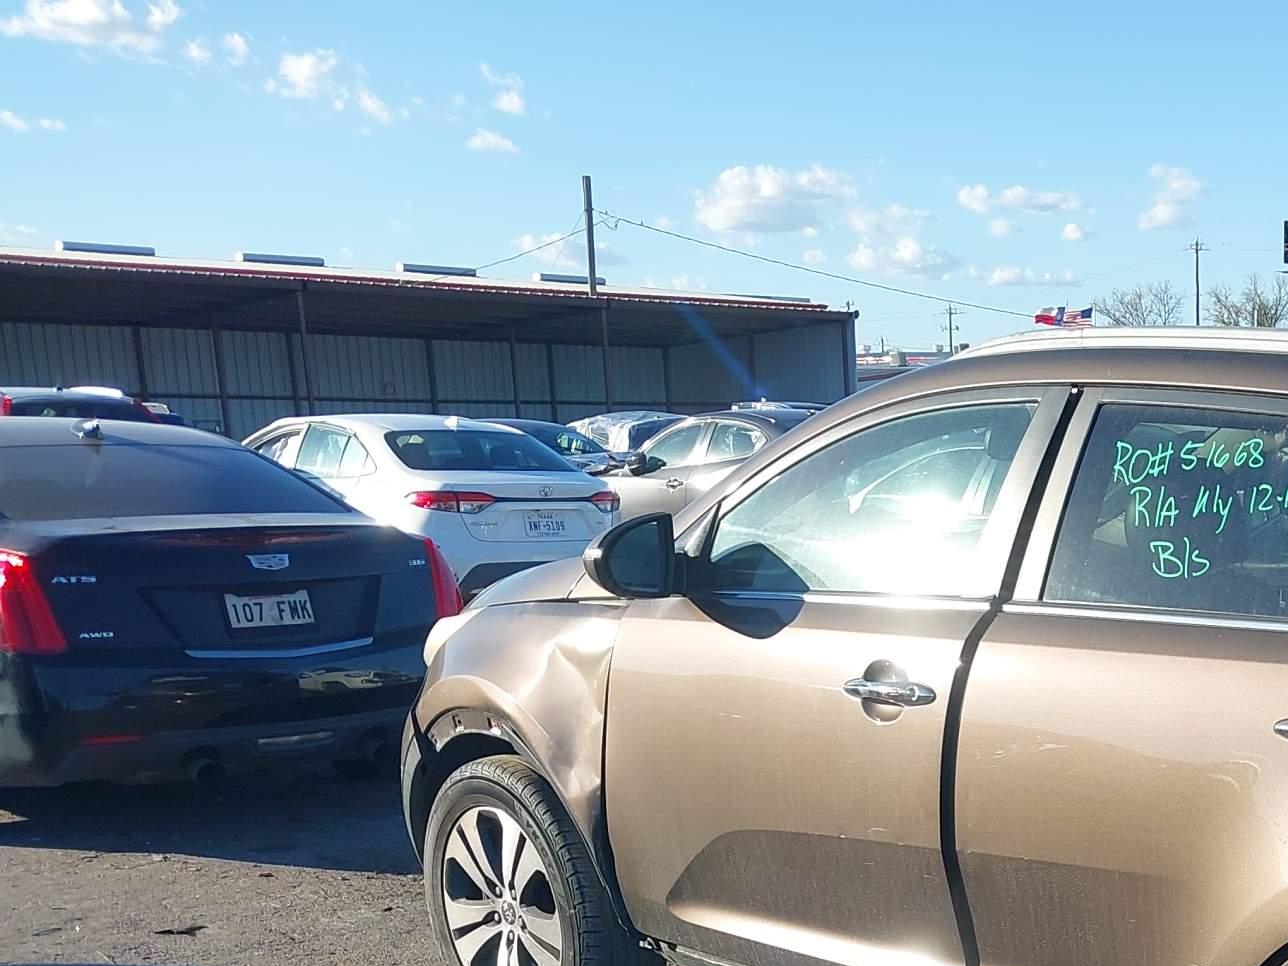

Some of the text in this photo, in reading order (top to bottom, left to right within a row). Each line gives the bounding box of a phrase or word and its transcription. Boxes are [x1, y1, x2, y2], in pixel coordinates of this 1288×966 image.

[51, 575, 97, 584] ATS
[231, 599, 312, 624] 107 FMK
[79, 631, 114, 639] AWD
